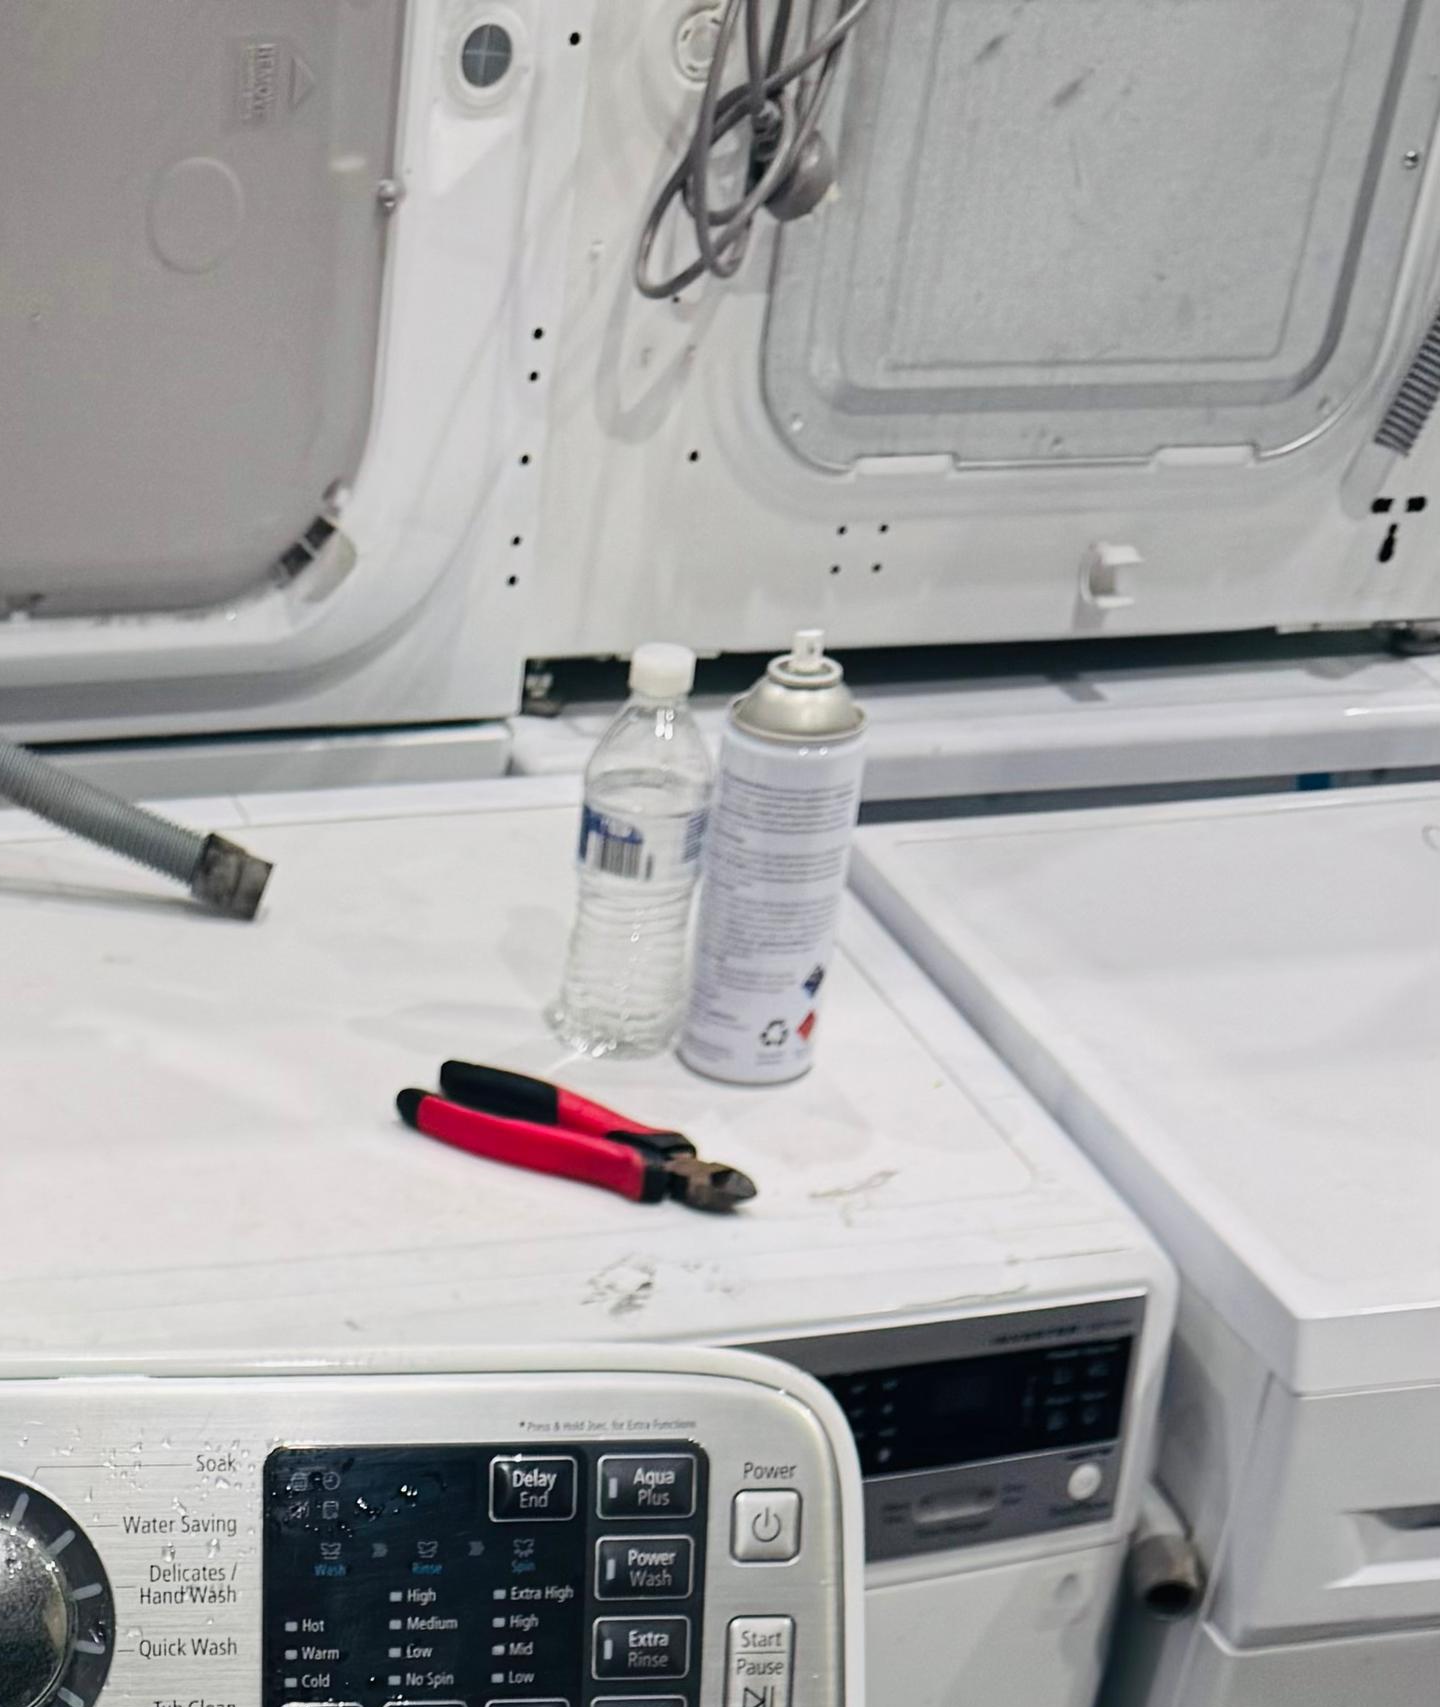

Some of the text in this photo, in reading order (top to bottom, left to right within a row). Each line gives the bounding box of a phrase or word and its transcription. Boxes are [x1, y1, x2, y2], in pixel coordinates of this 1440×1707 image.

[196, 1453, 237, 1472] Soak
[743, 1461, 798, 1480] Power
[512, 1469, 557, 1491] Delay
[633, 1467, 675, 1488] Aqua
[519, 1490, 549, 1508] End
[637, 1488, 670, 1507] Plus
[122, 1514, 237, 1537] Water Saving
[627, 1549, 676, 1567] Power
[149, 1564, 227, 1583] Delicates
[314, 1563, 347, 1576] Wash
[412, 1562, 443, 1576] Rinse
[510, 1560, 536, 1575] Spin
[629, 1569, 673, 1588] Wash
[139, 1584, 237, 1605] Hand Wash
[406, 1588, 437, 1606] High
[510, 1585, 574, 1604] Extra High
[302, 1618, 325, 1633] Hot
[406, 1615, 458, 1631] Medium
[509, 1614, 540, 1632] High
[628, 1630, 669, 1648] Extra
[741, 1630, 783, 1648] Start
[138, 1637, 237, 1661] Quick Wash
[301, 1646, 340, 1661] Warm
[406, 1644, 433, 1659] Low
[508, 1641, 534, 1656] Mid
[627, 1651, 669, 1669] Rinse
[736, 1658, 785, 1677] Pause
[301, 1673, 331, 1688] Cold
[406, 1671, 455, 1690] No Spin
[508, 1669, 535, 1684] Low
